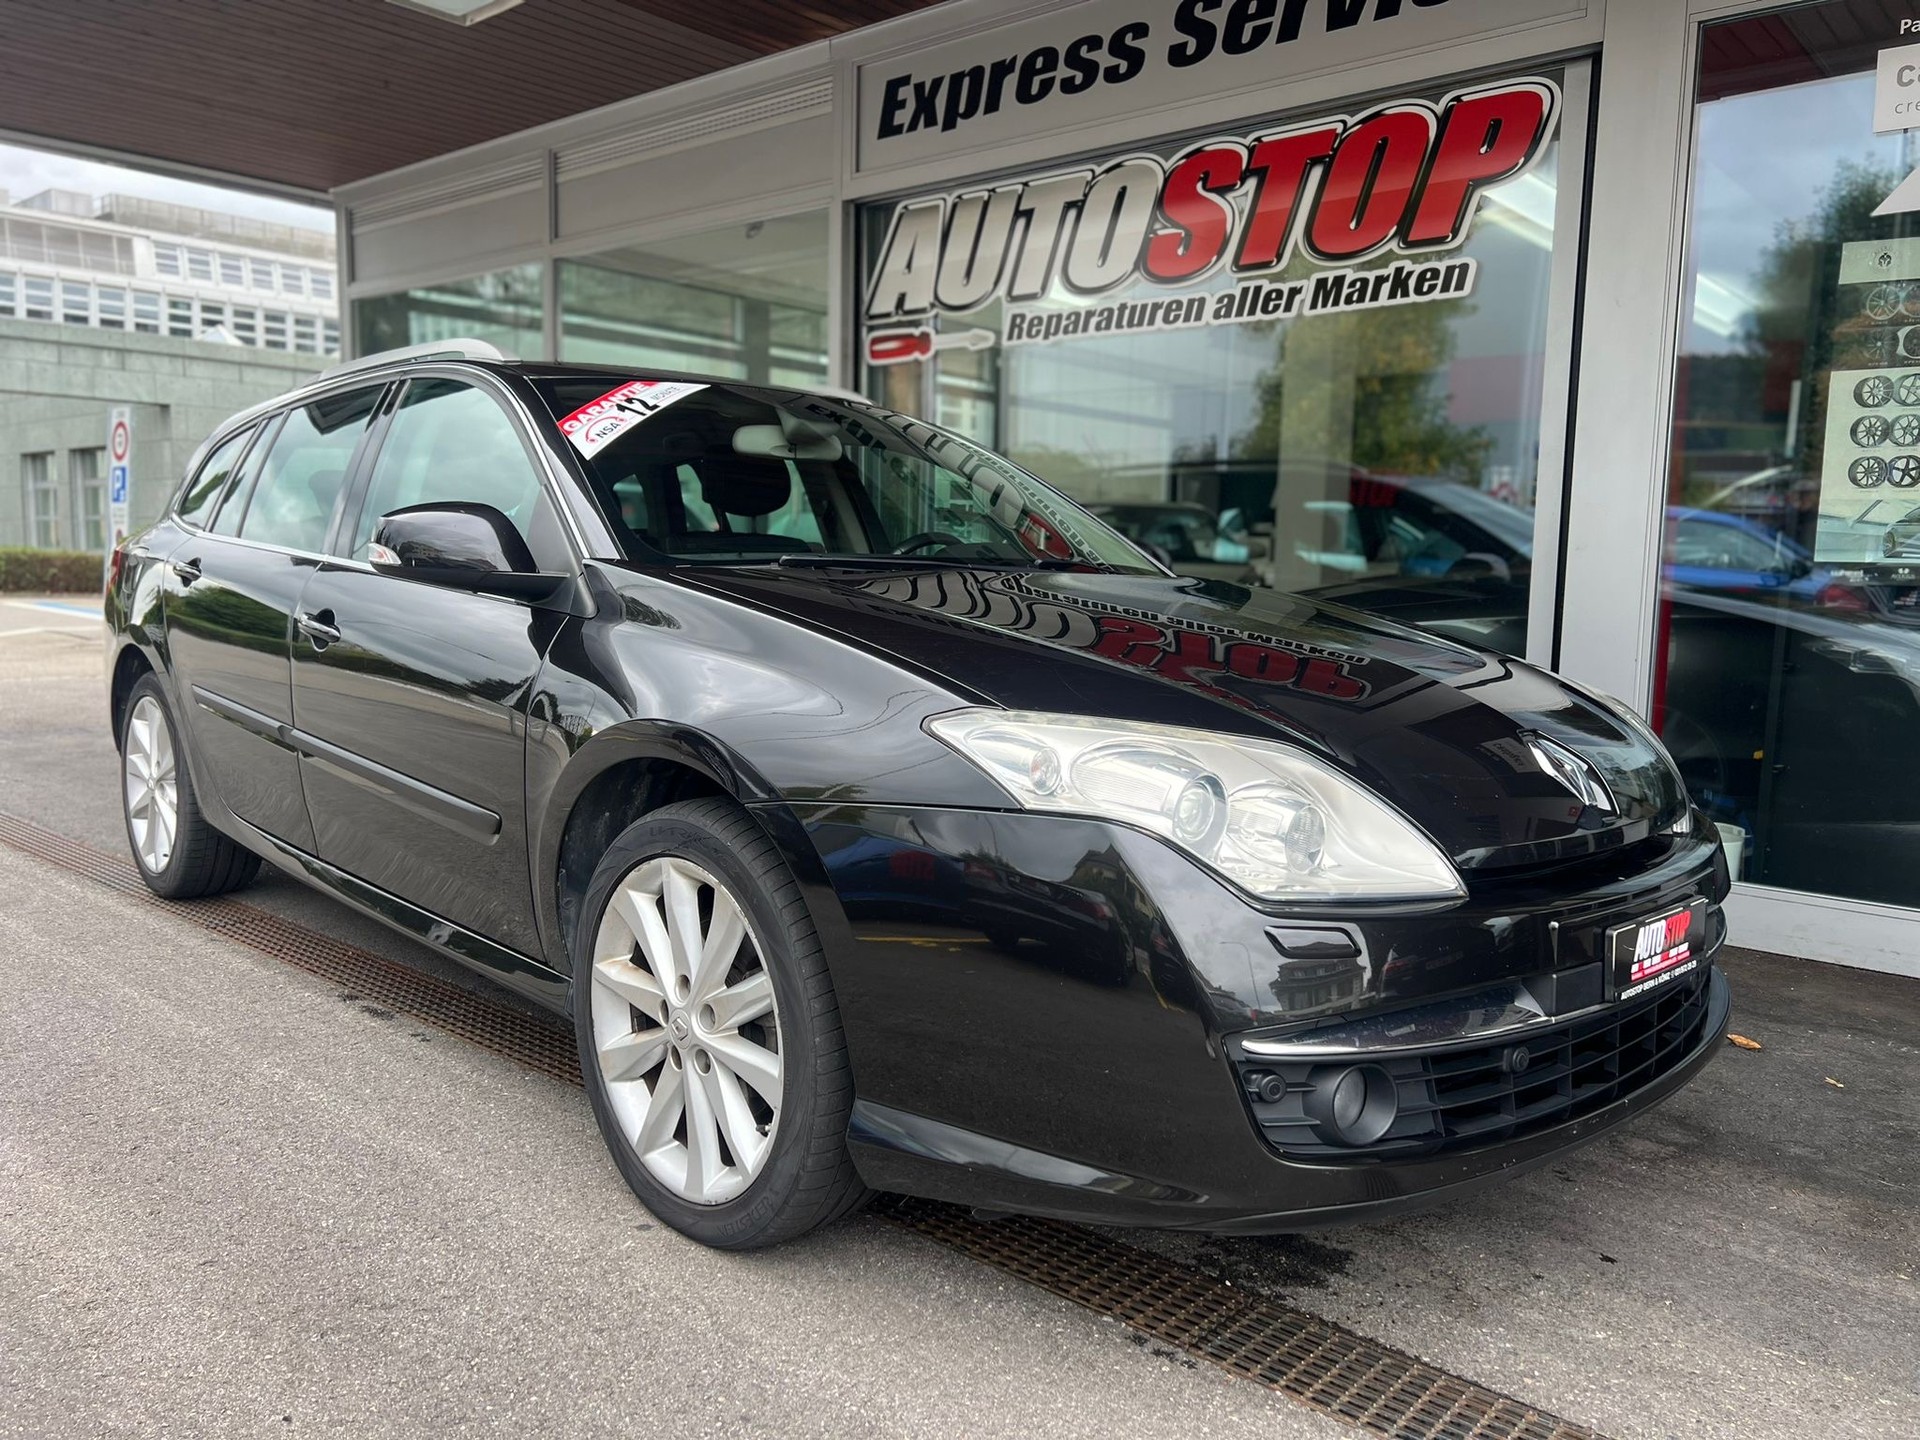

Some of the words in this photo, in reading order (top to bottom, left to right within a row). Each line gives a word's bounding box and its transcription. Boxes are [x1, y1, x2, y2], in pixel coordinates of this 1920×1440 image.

[876, 22, 1151, 140] Express
[866, 82, 1556, 318] AUTOSTOP
[1006, 298, 1203, 341] Reparaturen
[1211, 284, 1305, 320] aller
[1308, 261, 1471, 310] Marken
[562, 383, 647, 432] GARANTIE
[595, 421, 621, 439] NSA
[616, 398, 661, 416] 12
[1633, 910, 1691, 962] AUTOSTOP
